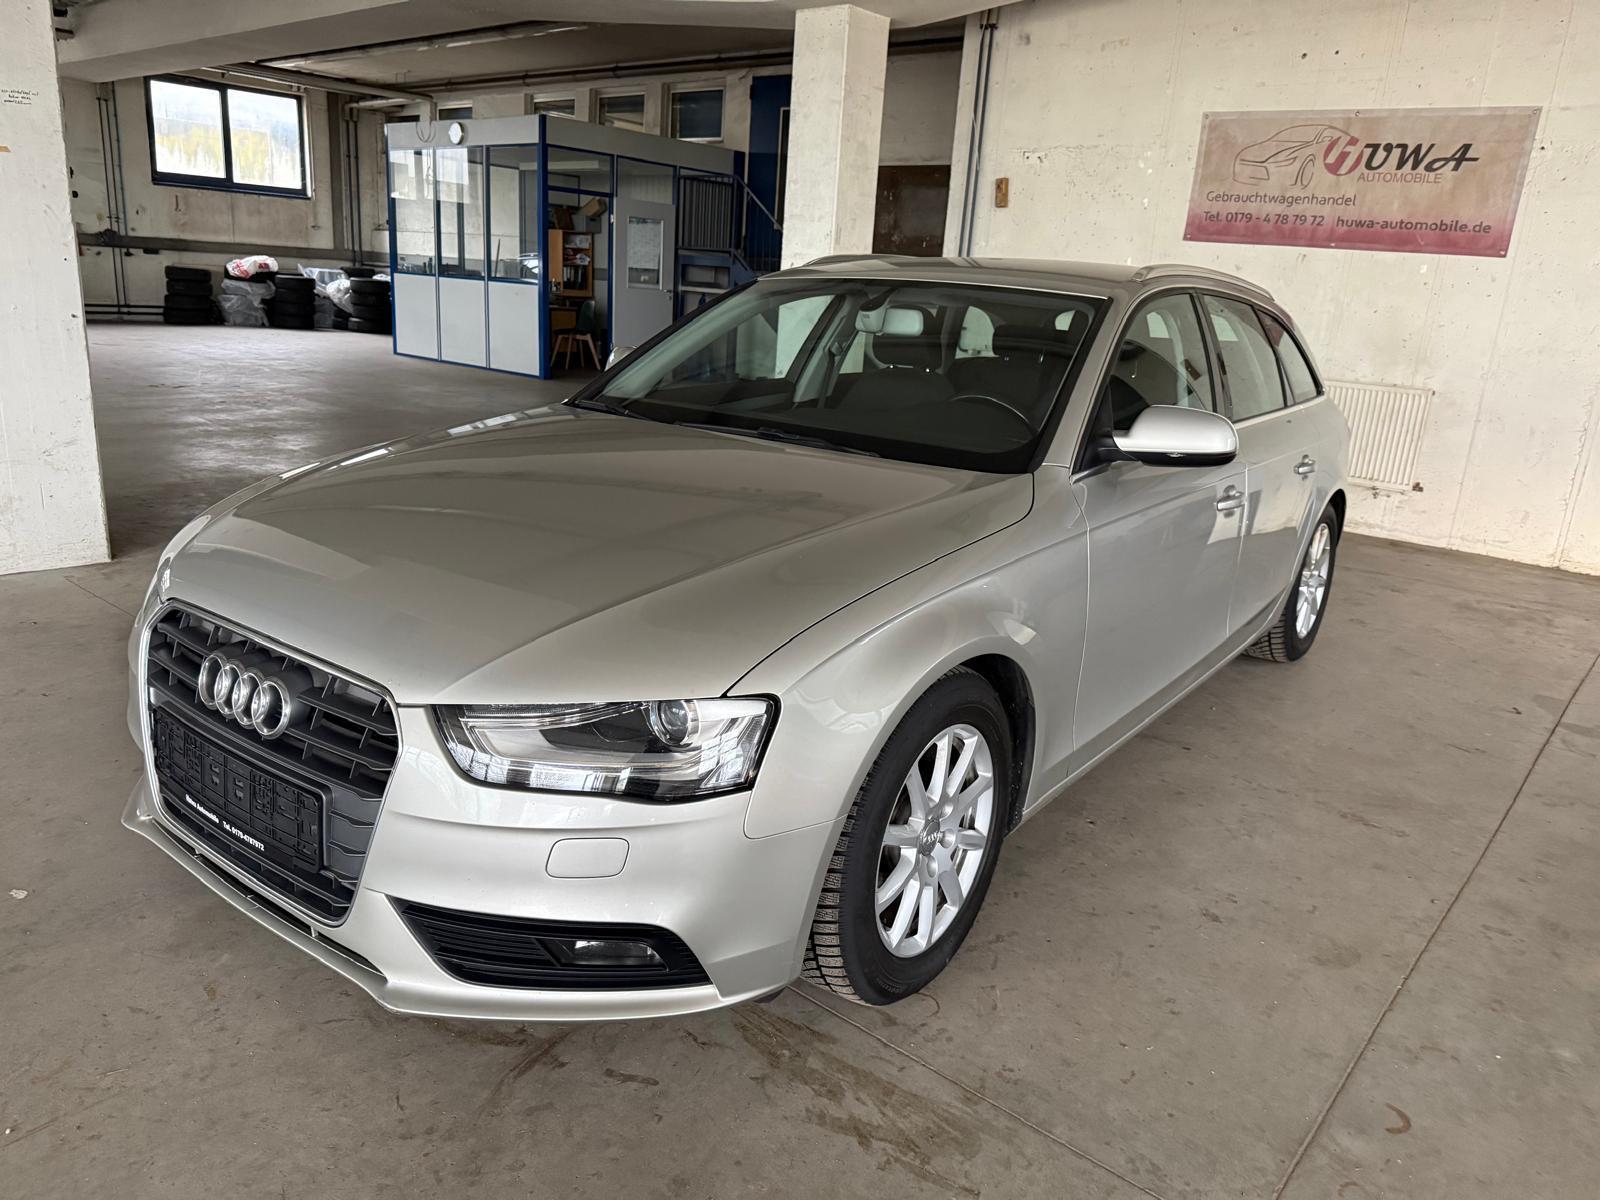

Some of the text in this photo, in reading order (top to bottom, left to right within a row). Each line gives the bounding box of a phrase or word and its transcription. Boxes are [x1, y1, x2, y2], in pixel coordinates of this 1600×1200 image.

[1357, 172, 1443, 184] AUTOMOBILE
[1206, 190, 1357, 208] Gebrauchtwagenhandel
[1203, 210, 1223, 223] Tel.
[1226, 211, 1252, 224] 0179
[1263, 213, 1271, 225] 4
[1274, 213, 1290, 226] 78
[1292, 214, 1308, 226] 79
[1309, 215, 1324, 227] 72
[1336, 215, 1492, 234] huwa-automobile.de
